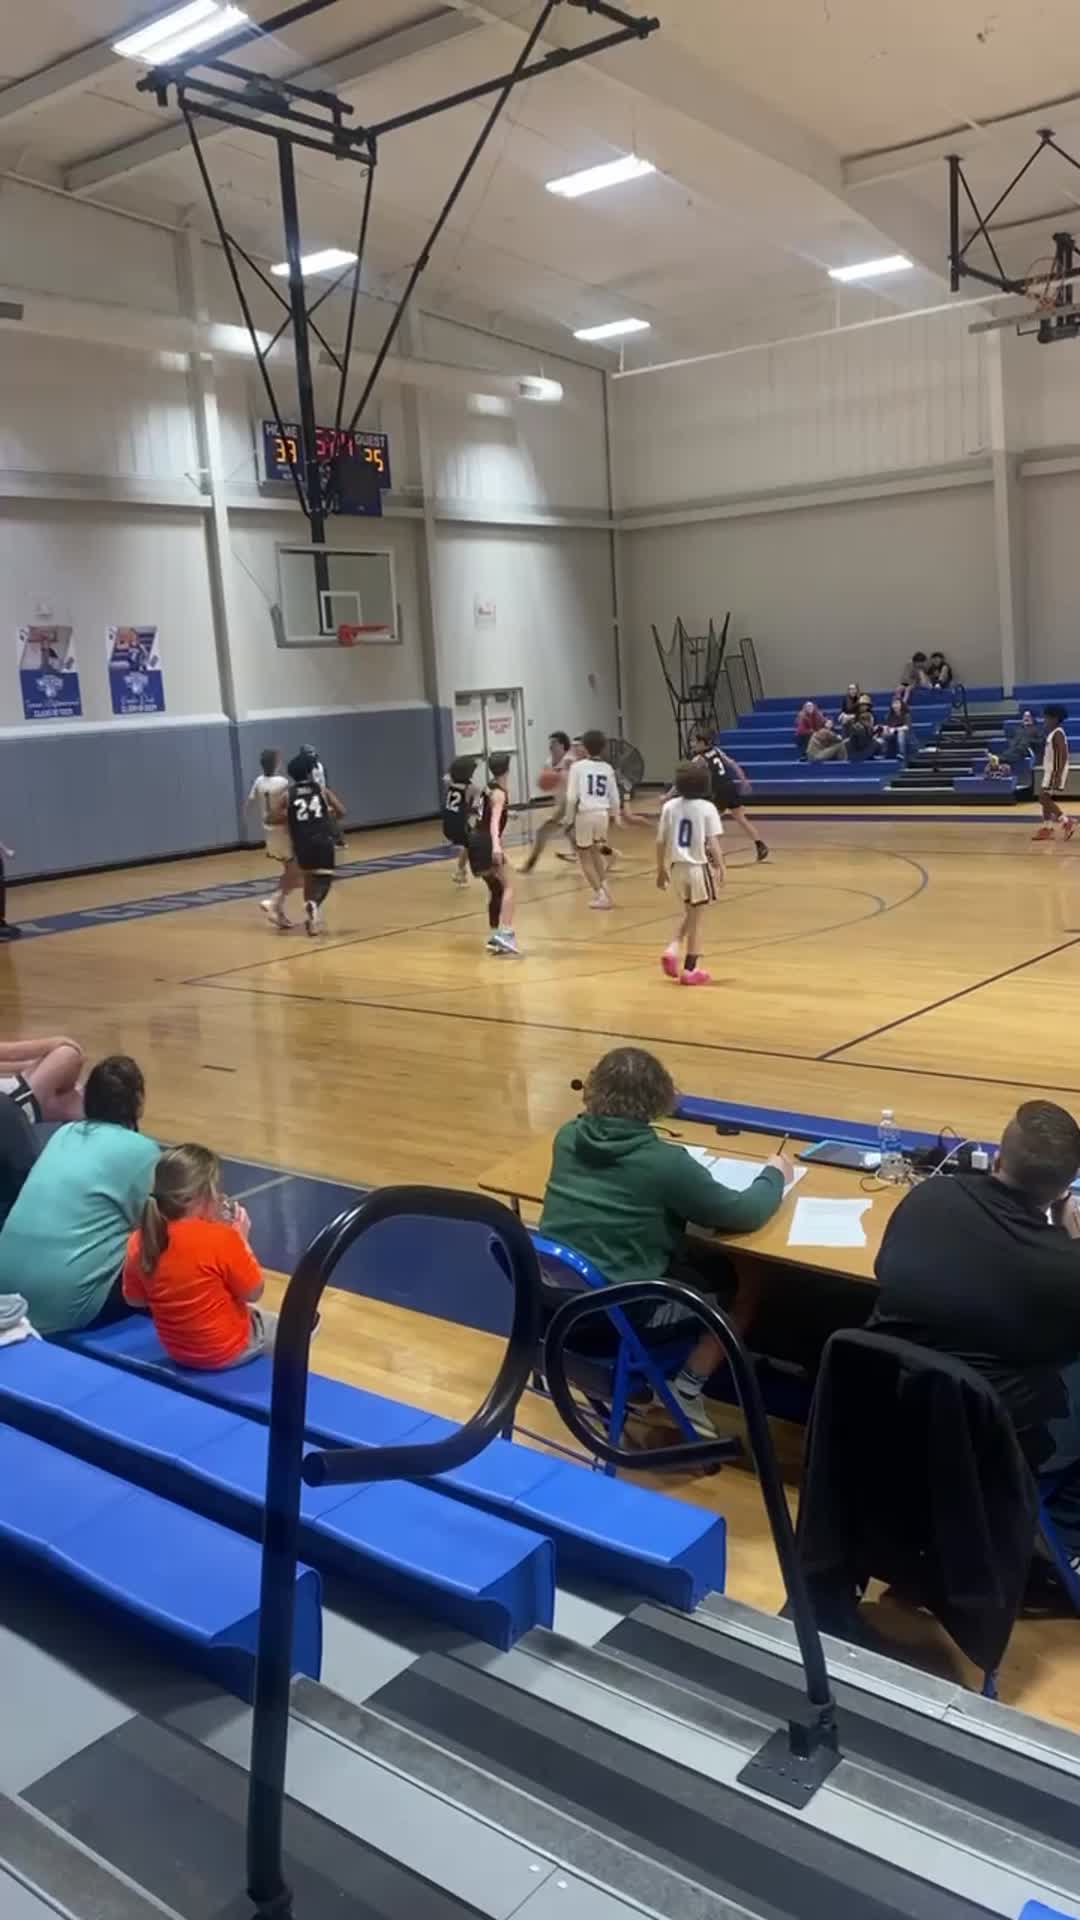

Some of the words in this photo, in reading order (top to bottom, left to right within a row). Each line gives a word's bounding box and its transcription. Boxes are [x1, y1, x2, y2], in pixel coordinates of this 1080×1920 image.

[713, 757, 726, 776] 3
[587, 774, 607, 797] 15
[293, 795, 323, 821] 24
[678, 818, 693, 848] 0
